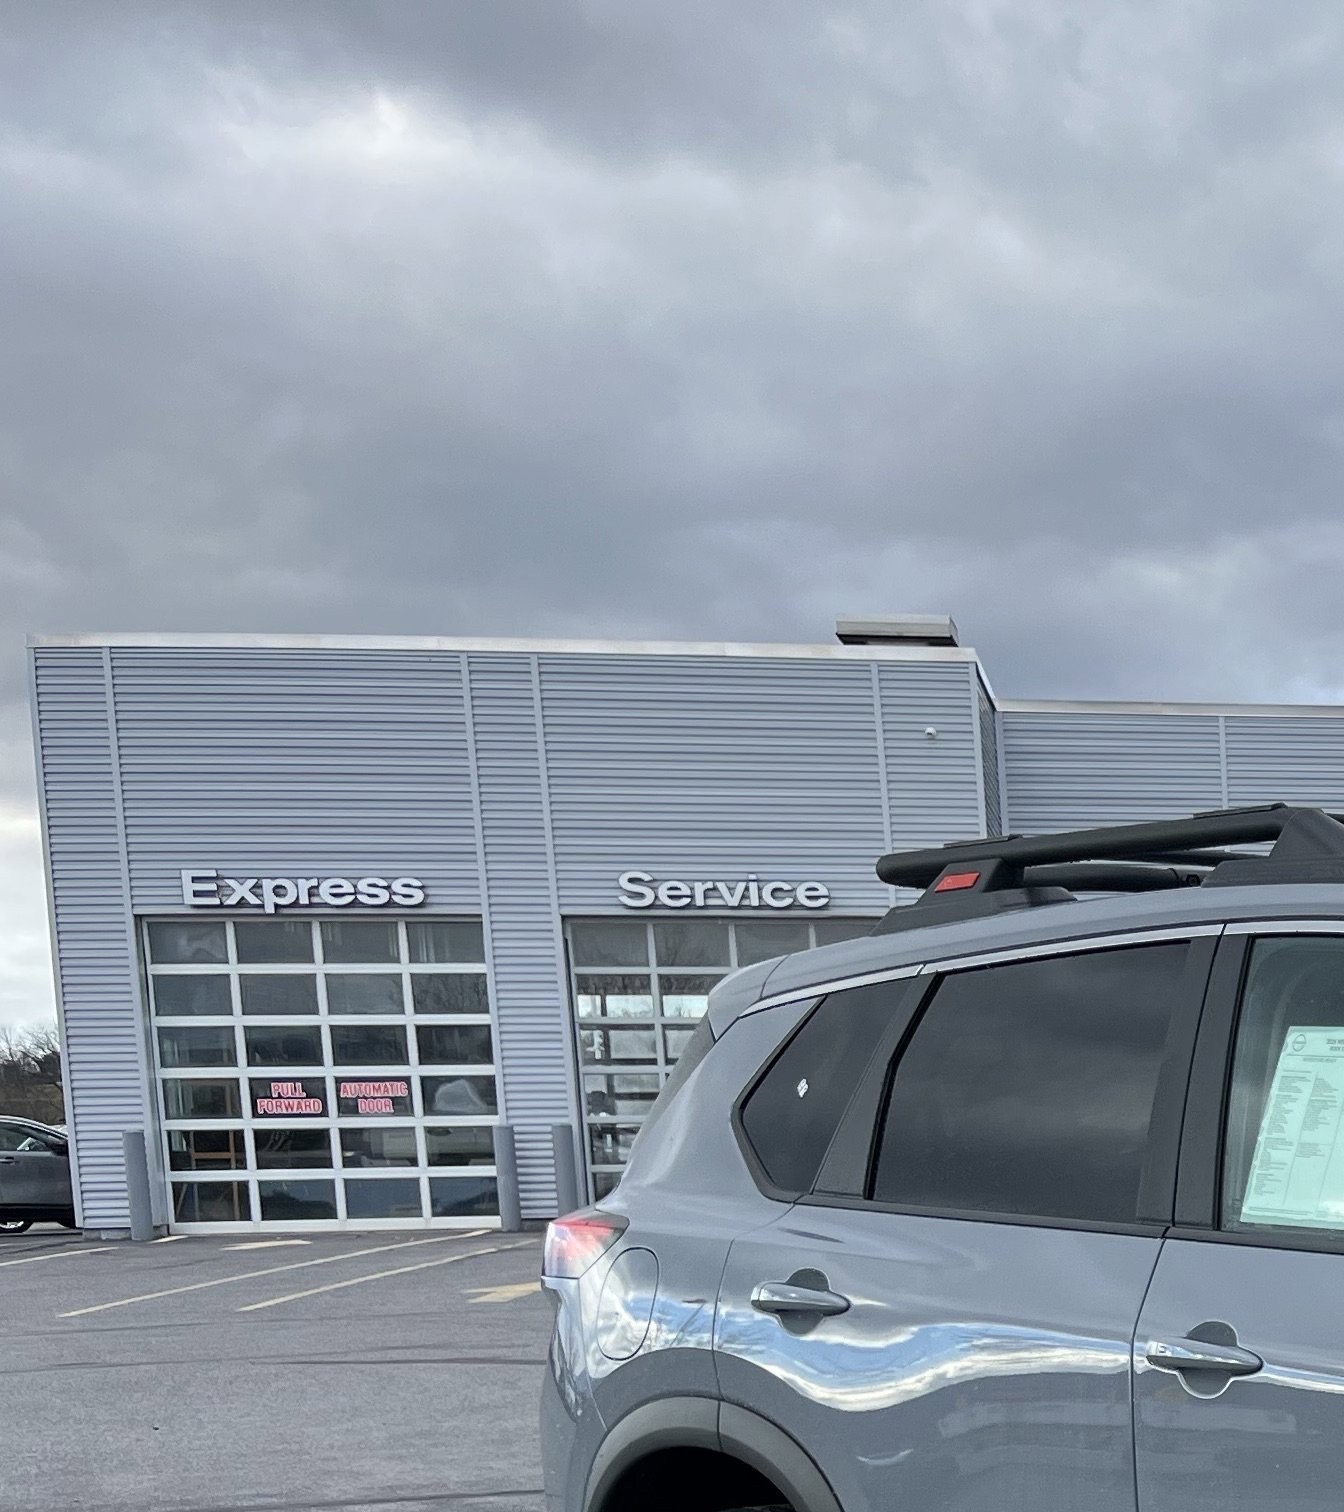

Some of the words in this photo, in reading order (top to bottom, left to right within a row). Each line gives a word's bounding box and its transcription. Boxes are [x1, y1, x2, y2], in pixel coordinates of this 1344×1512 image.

[180, 868, 425, 914] Express
[618, 870, 830, 908] Service
[270, 1082, 307, 1098] PULL
[340, 1081, 408, 1098] AUTOMATIC
[256, 1098, 323, 1114] FORWARD
[358, 1098, 394, 1114] DOOR
